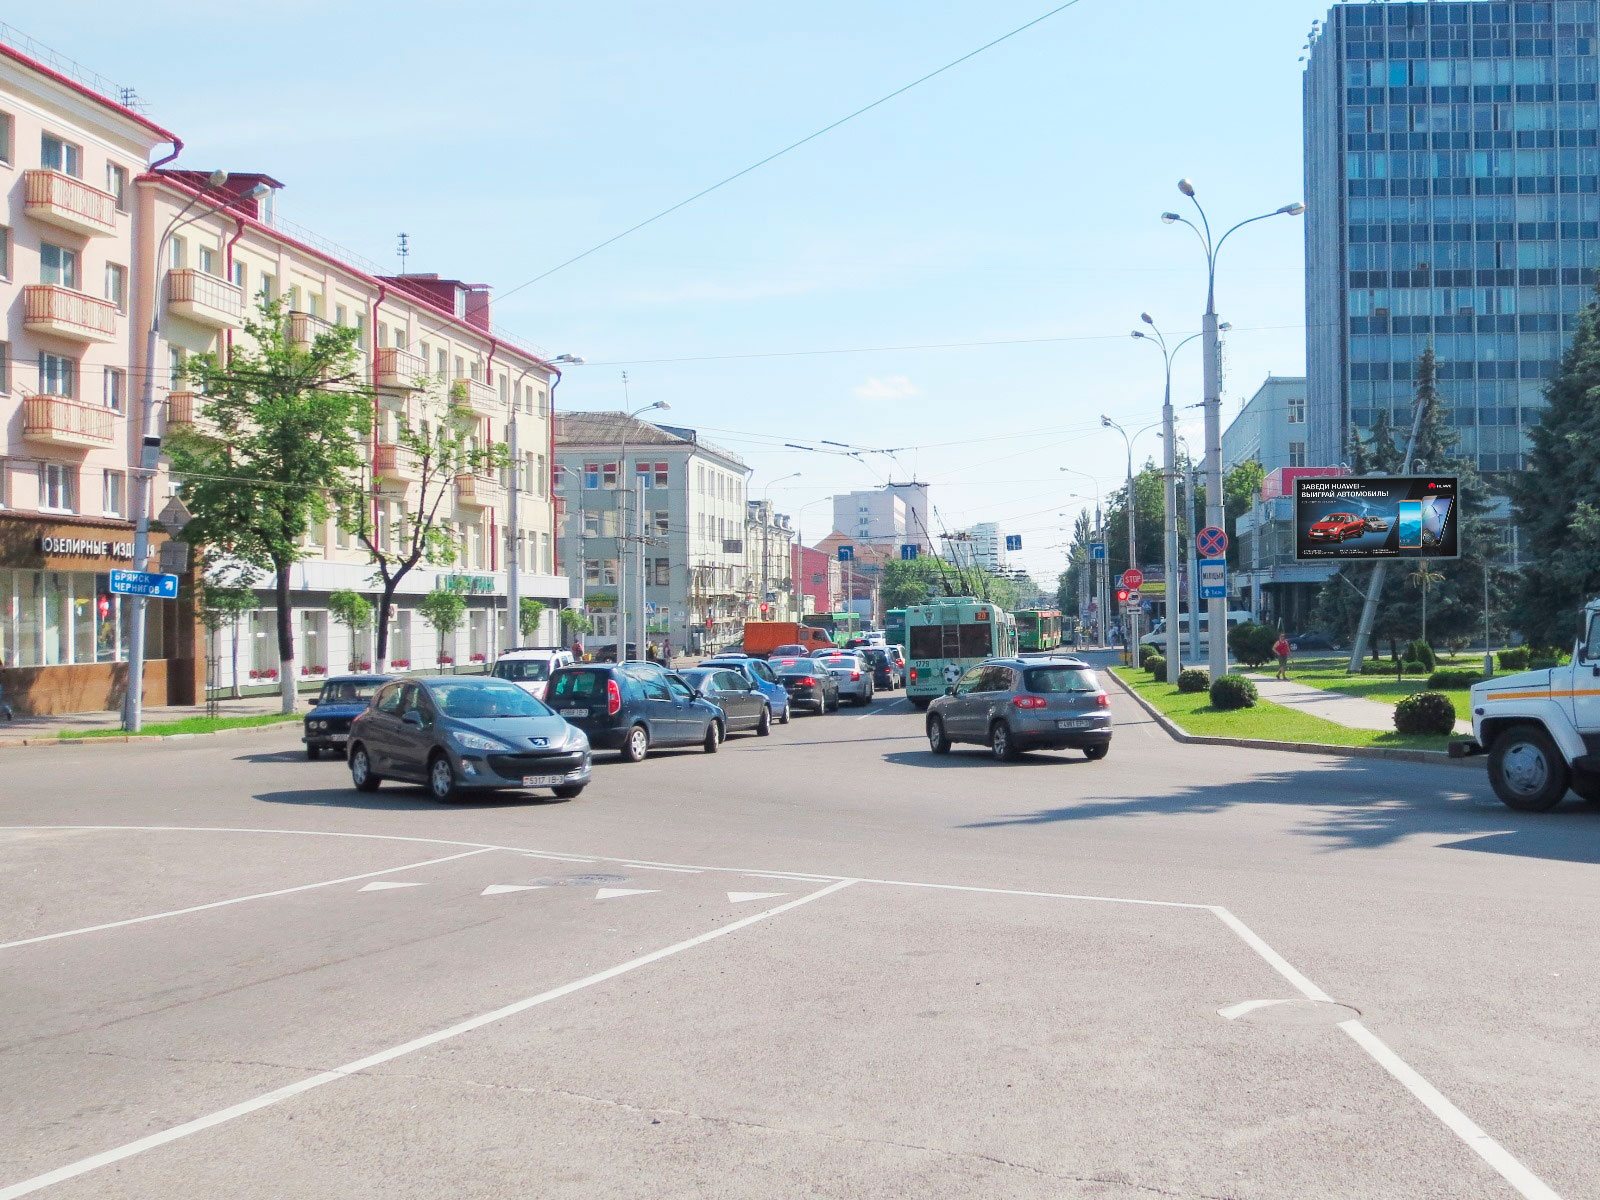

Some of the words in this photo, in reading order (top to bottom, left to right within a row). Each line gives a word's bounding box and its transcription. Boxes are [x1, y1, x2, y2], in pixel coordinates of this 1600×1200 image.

[1301, 483, 1330, 491] ЗАВЕДИ
[1301, 490, 1335, 498] ВЫИГРАЙ
[1336, 490, 1389, 498] АВТОМОБИЛЬ!
[42, 536, 108, 555] ЮВЕЛИРНЫЕ
[113, 541, 155, 558] ИЗДЯ
[114, 572, 150, 583] БРЯНСК
[1125, 573, 1142, 583] STOP
[114, 582, 160, 594] ЧЕРНИГОВ
